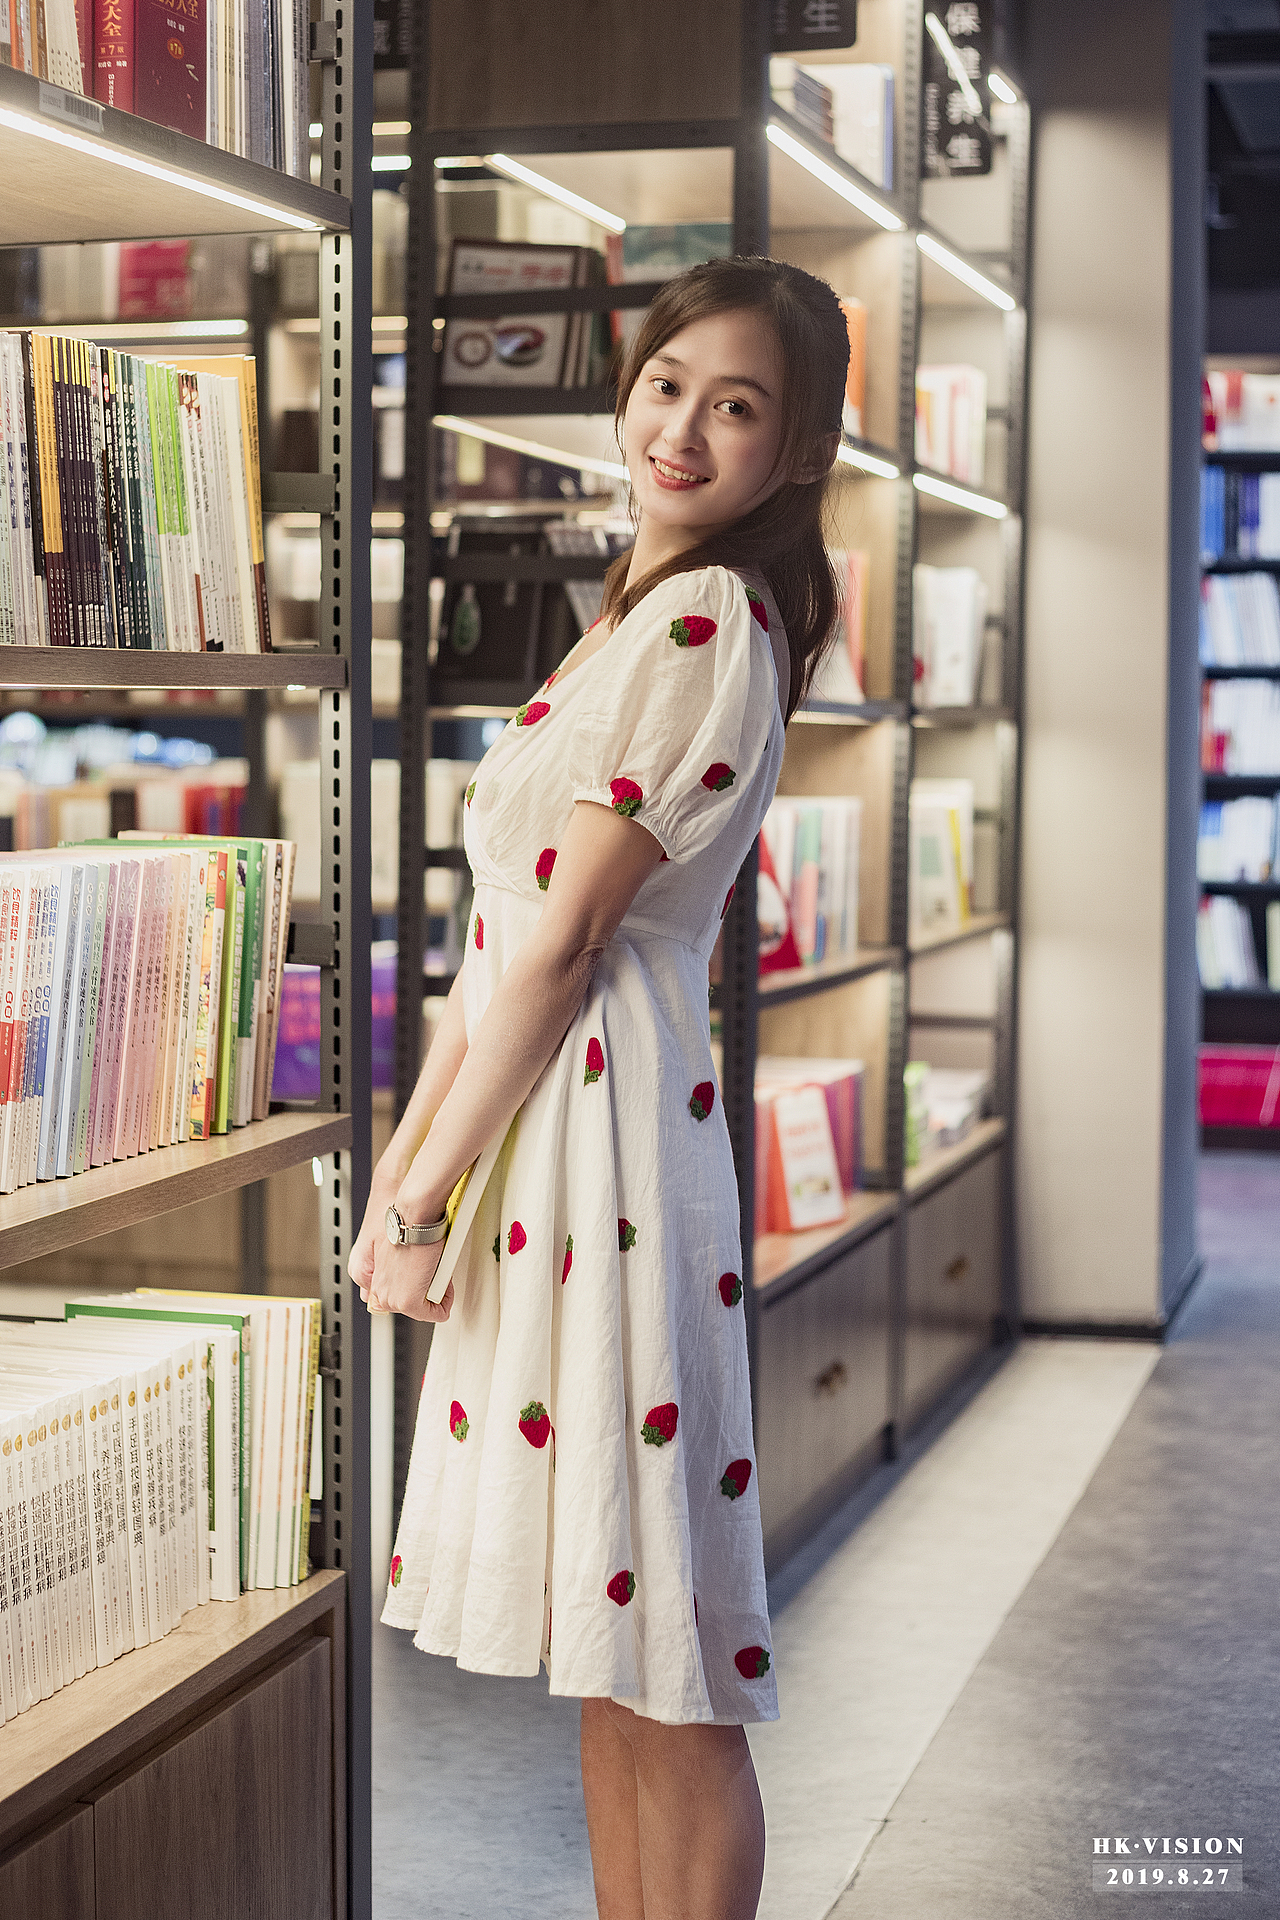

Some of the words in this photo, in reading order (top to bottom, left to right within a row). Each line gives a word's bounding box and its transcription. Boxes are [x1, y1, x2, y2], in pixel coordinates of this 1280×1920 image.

[18, 1500, 33, 1600] 快速调理糖尿病
[31, 1494, 47, 1595] 快速调理糖尿病
